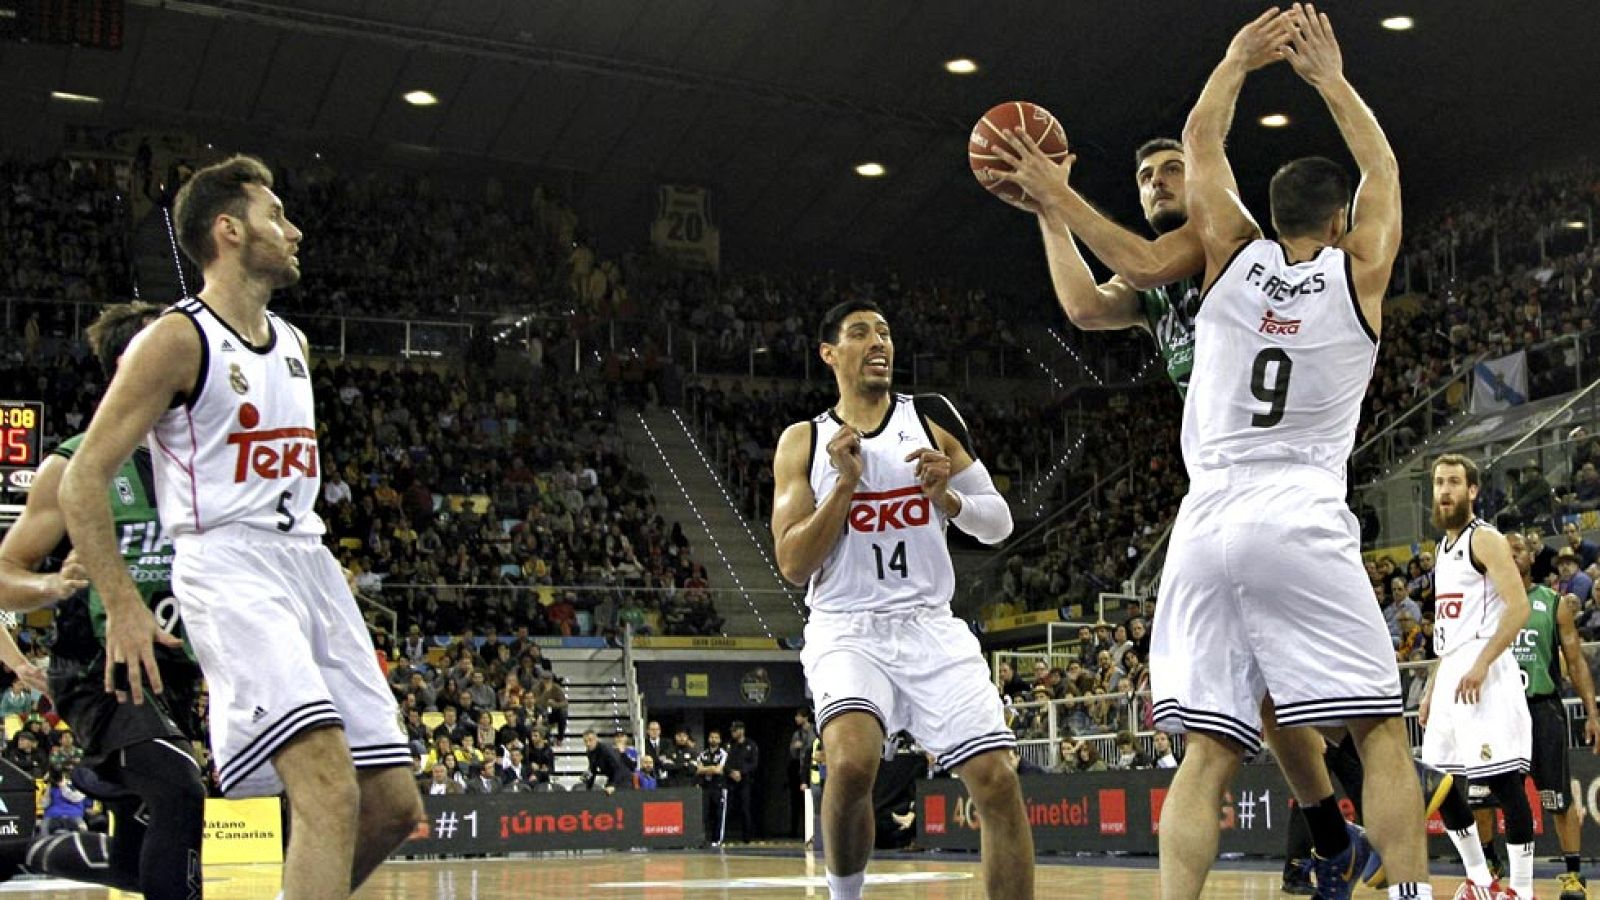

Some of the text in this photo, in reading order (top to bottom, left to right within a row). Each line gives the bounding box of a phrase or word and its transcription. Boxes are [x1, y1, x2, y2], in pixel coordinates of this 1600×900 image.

[668, 211, 703, 243] 20
[1250, 347, 1293, 428] 9
[0, 408, 35, 429] :08
[0, 428, 28, 462] 5
[276, 489, 295, 532] 5
[850, 485, 930, 532] eka
[872, 540, 909, 581] 14
[435, 807, 625, 839] #1 ¡únete!
[1026, 796, 1089, 826] únete!
[1238, 789, 1271, 829] #1
[0, 820, 19, 834] nk
[215, 830, 275, 839] Canarias
